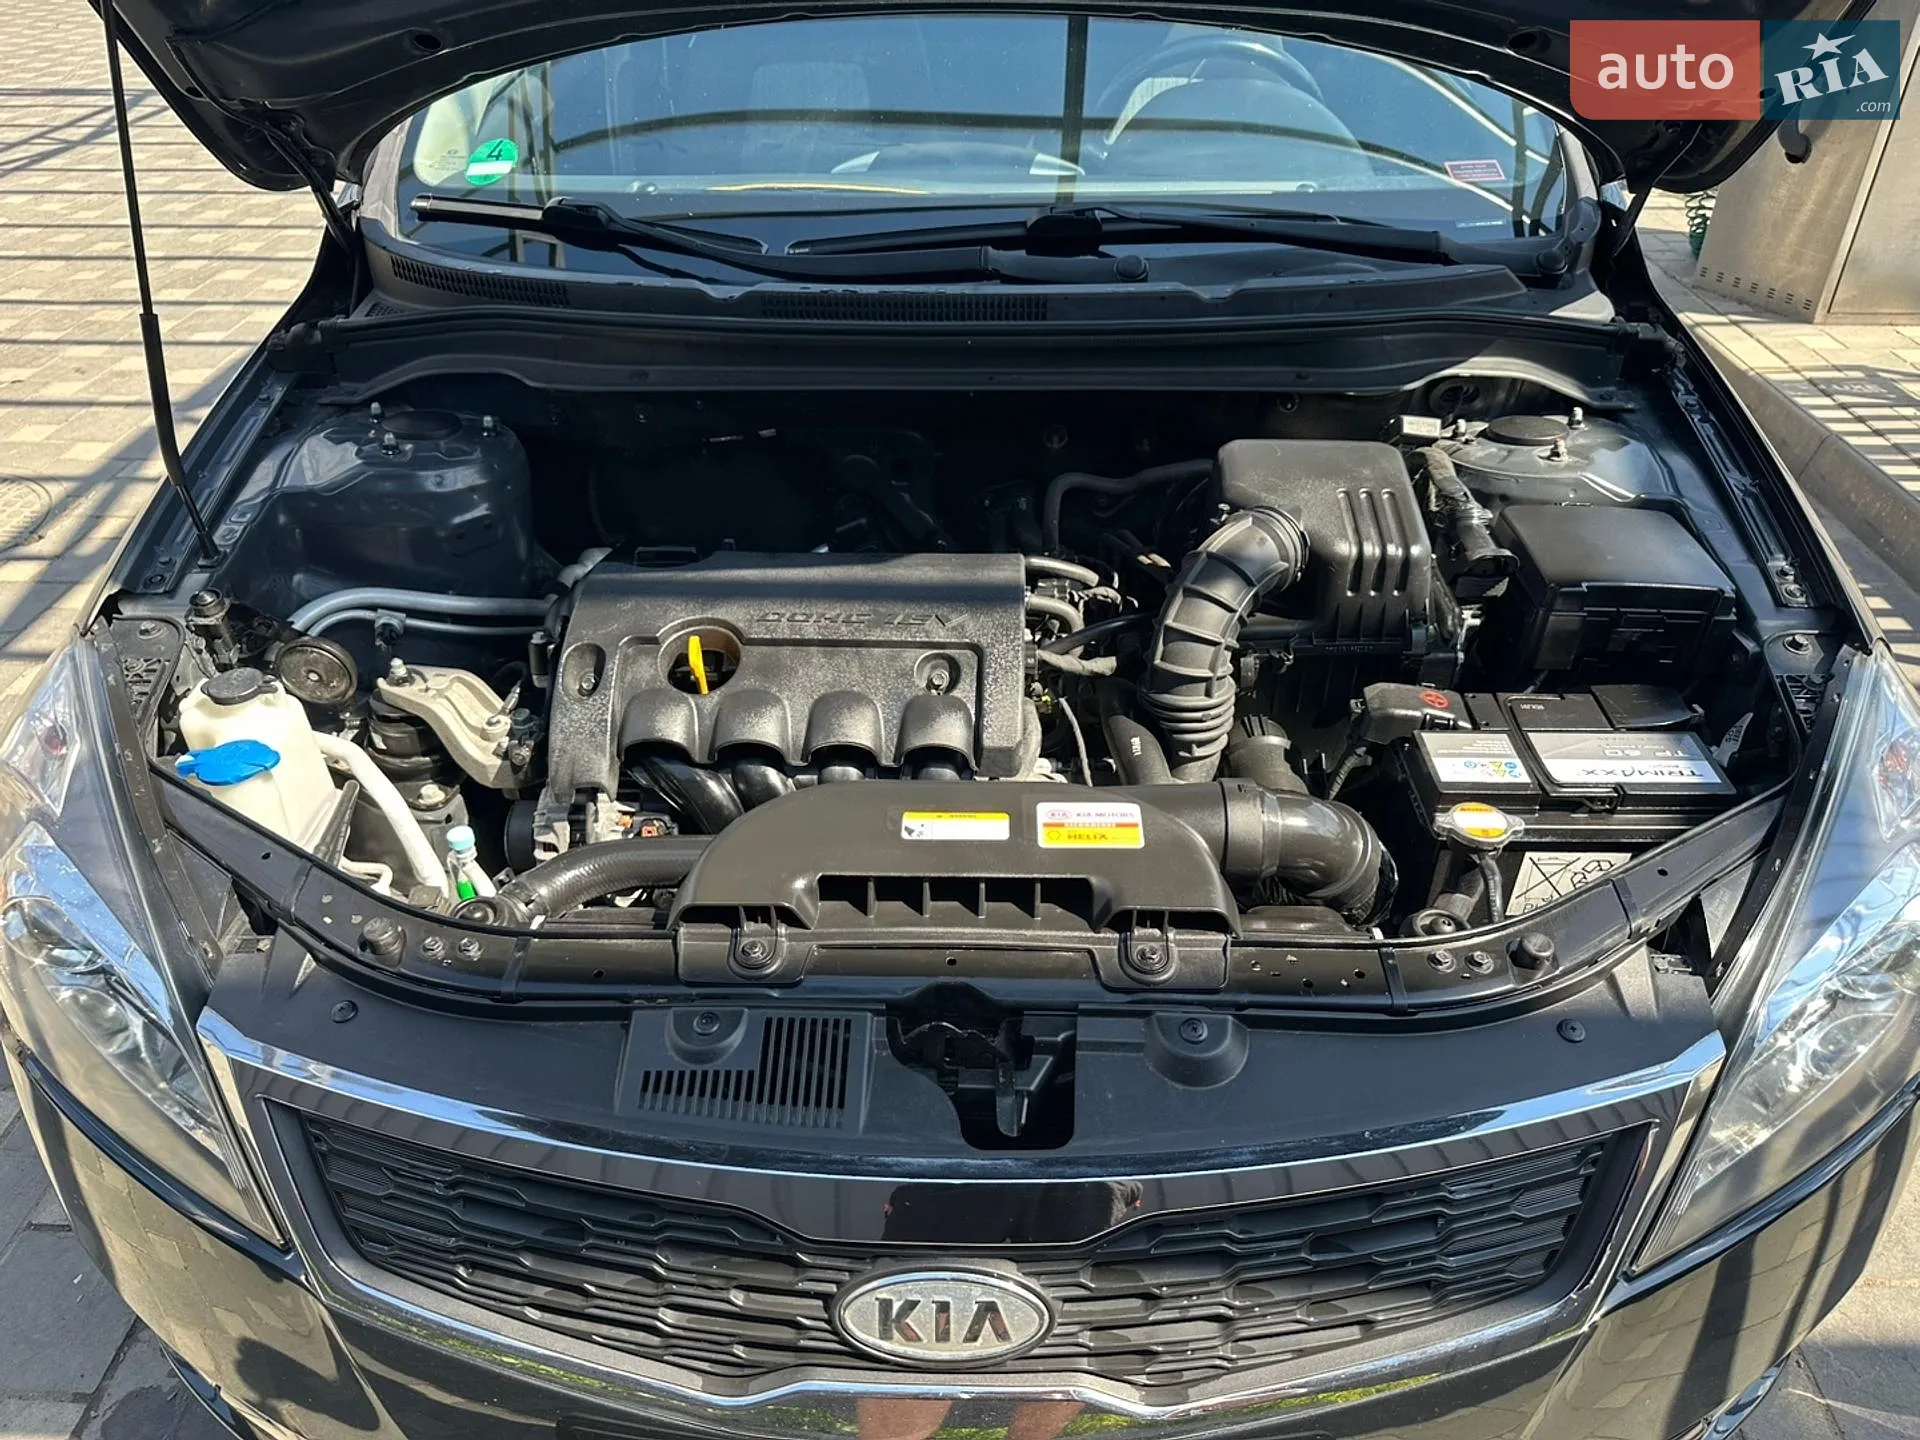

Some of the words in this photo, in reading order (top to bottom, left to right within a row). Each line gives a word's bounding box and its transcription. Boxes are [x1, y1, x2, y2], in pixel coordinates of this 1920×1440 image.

[486, 139, 504, 161] 4
[1067, 832, 1109, 841] HELIX
[875, 1297, 1012, 1343] KIA
